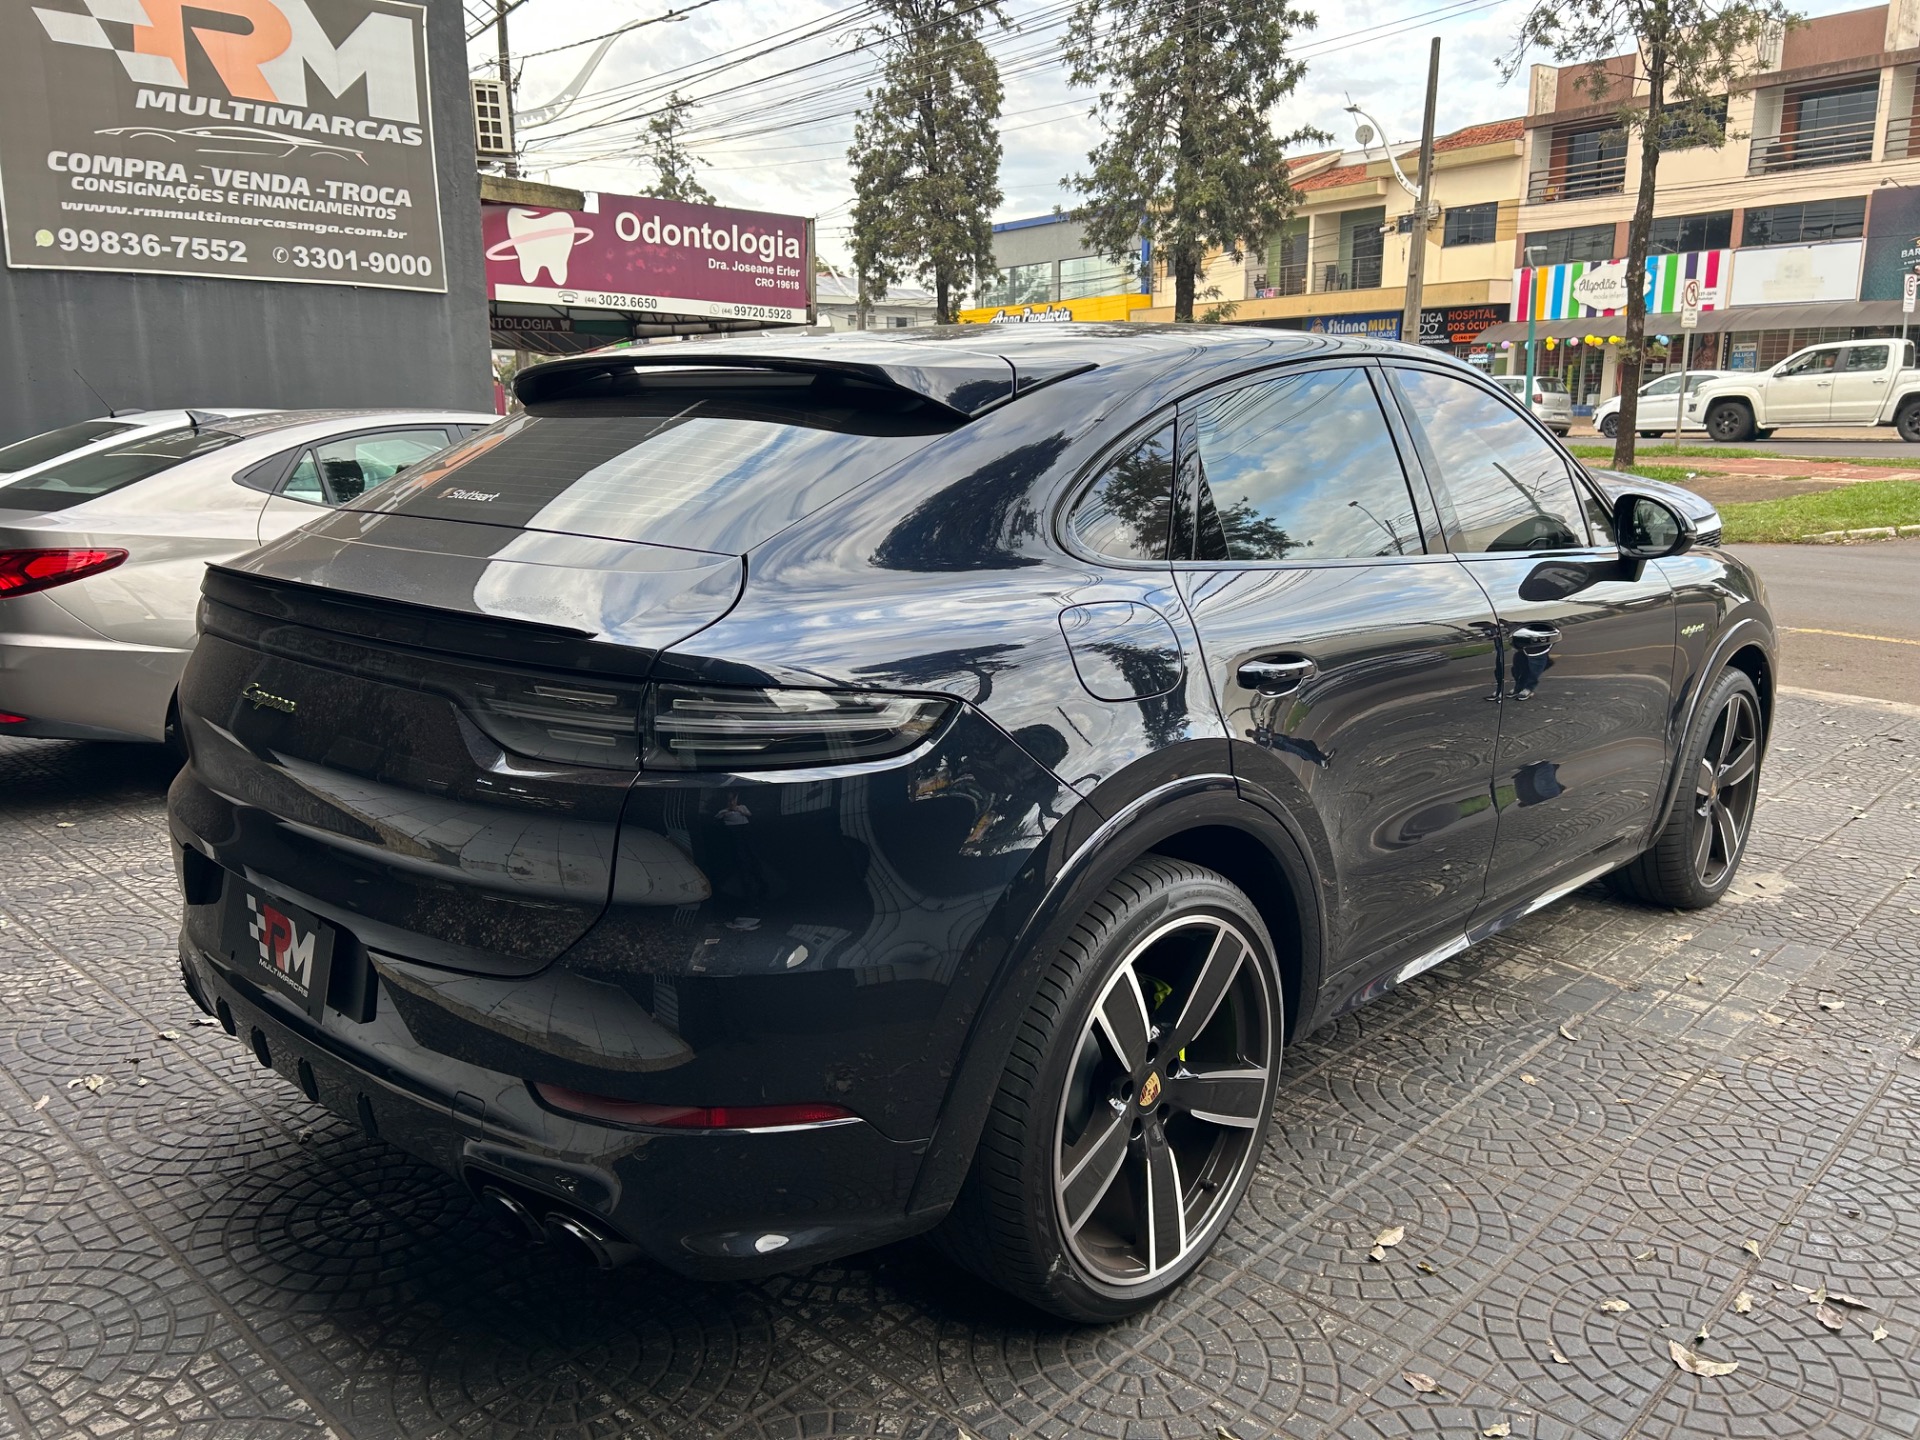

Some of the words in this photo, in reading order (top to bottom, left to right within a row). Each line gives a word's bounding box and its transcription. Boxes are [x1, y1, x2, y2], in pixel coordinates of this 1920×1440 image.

[135, 88, 424, 147] MULTIMARCAS
[47, 150, 188, 184] COMPRA
[210, 167, 311, 197] VENDA
[71, 176, 224, 204] CONSIGNAÇÕES
[227, 191, 239, 205] E
[242, 192, 397, 221] FINANCIAMENTOS
[60, 201, 408, 240] www.rmmultimarcasmga.com.br
[614, 211, 800, 263] Odontologia
[57, 227, 248, 264] 99836-7552
[292, 246, 433, 277] 3301-9000
[708, 257, 730, 271] Dra.
[732, 260, 775, 275] Joseane
[777, 265, 800, 277] Erler
[755, 277, 774, 288] CRO
[776, 279, 800, 290] 19618
[1579, 278, 1617, 293] Algodão
[584, 297, 597, 305] (44)
[598, 293, 658, 309] 3023.6650
[734, 305, 793, 320] 99720.5928
[1022, 305, 1071, 323] Papelaria
[1448, 309, 1496, 320] HOSPITAL
[1447, 322, 1466, 331] DOS
[258, 958, 309, 998] MULTIMARCAS
